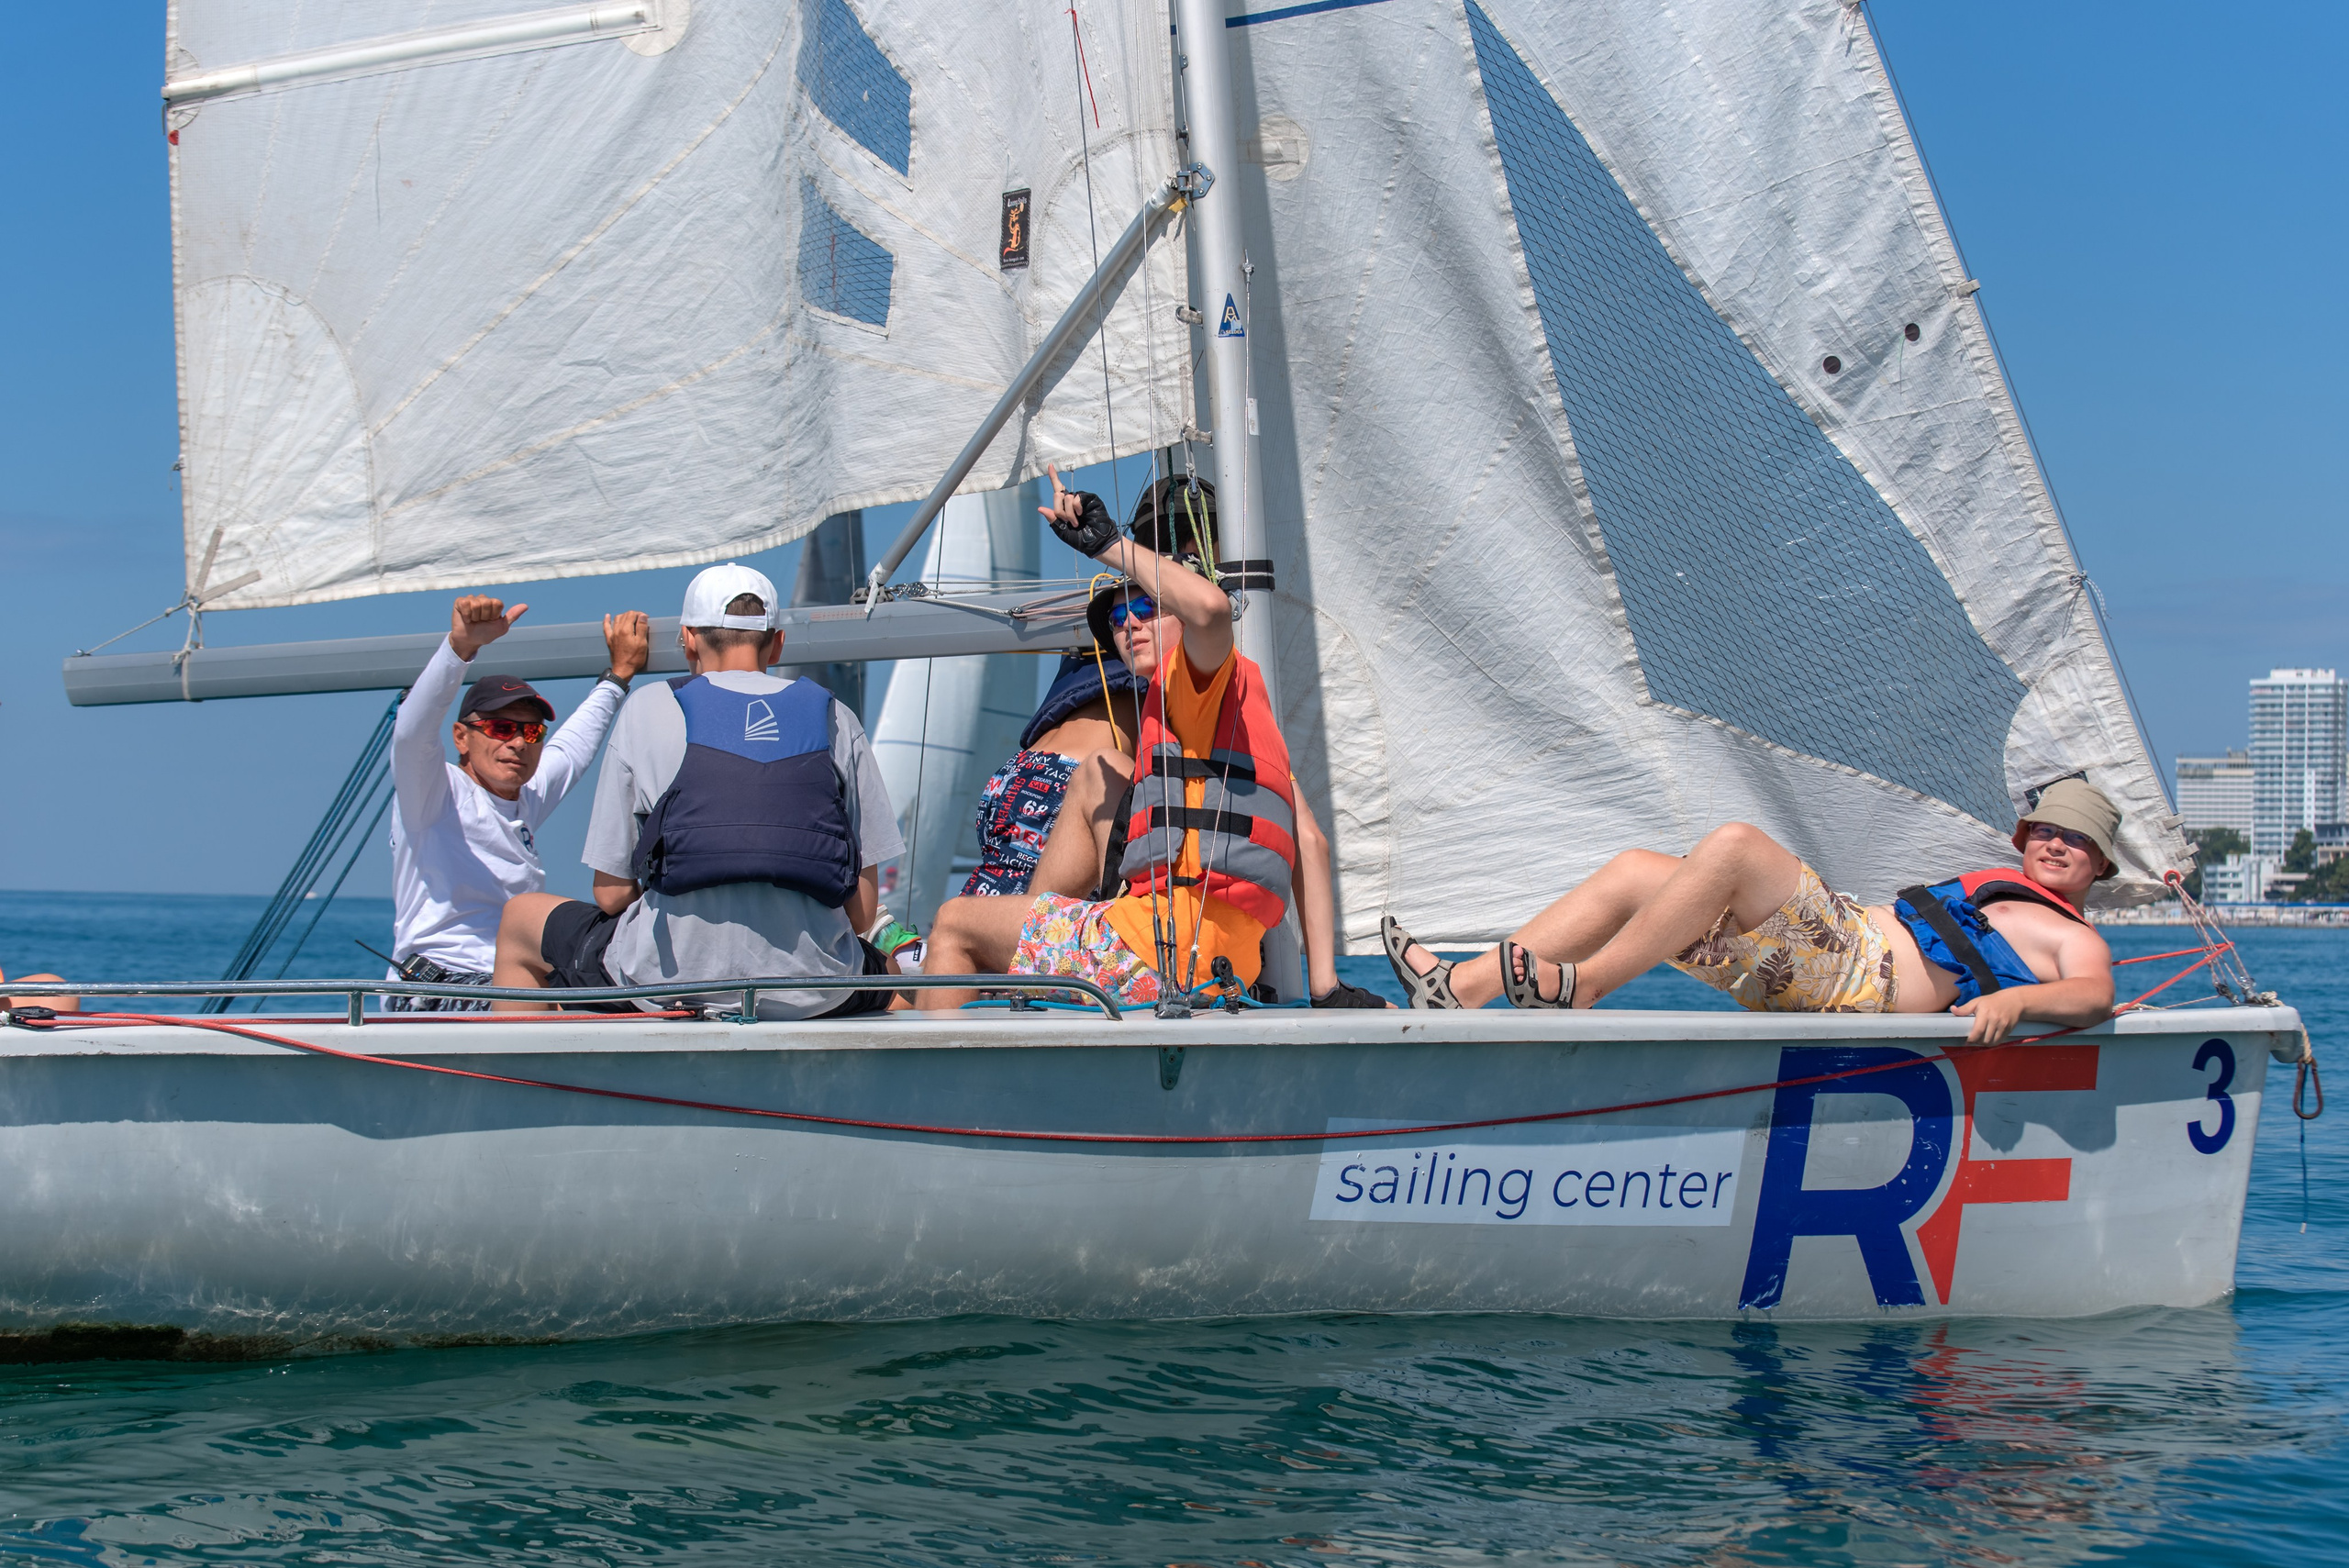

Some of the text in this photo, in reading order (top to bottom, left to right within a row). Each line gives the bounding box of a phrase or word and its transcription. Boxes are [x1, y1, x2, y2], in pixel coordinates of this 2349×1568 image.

[2187, 1039, 2236, 1154] 3
[1335, 1151, 1733, 1220] sailing center
[1738, 1044, 2100, 1310] RF
